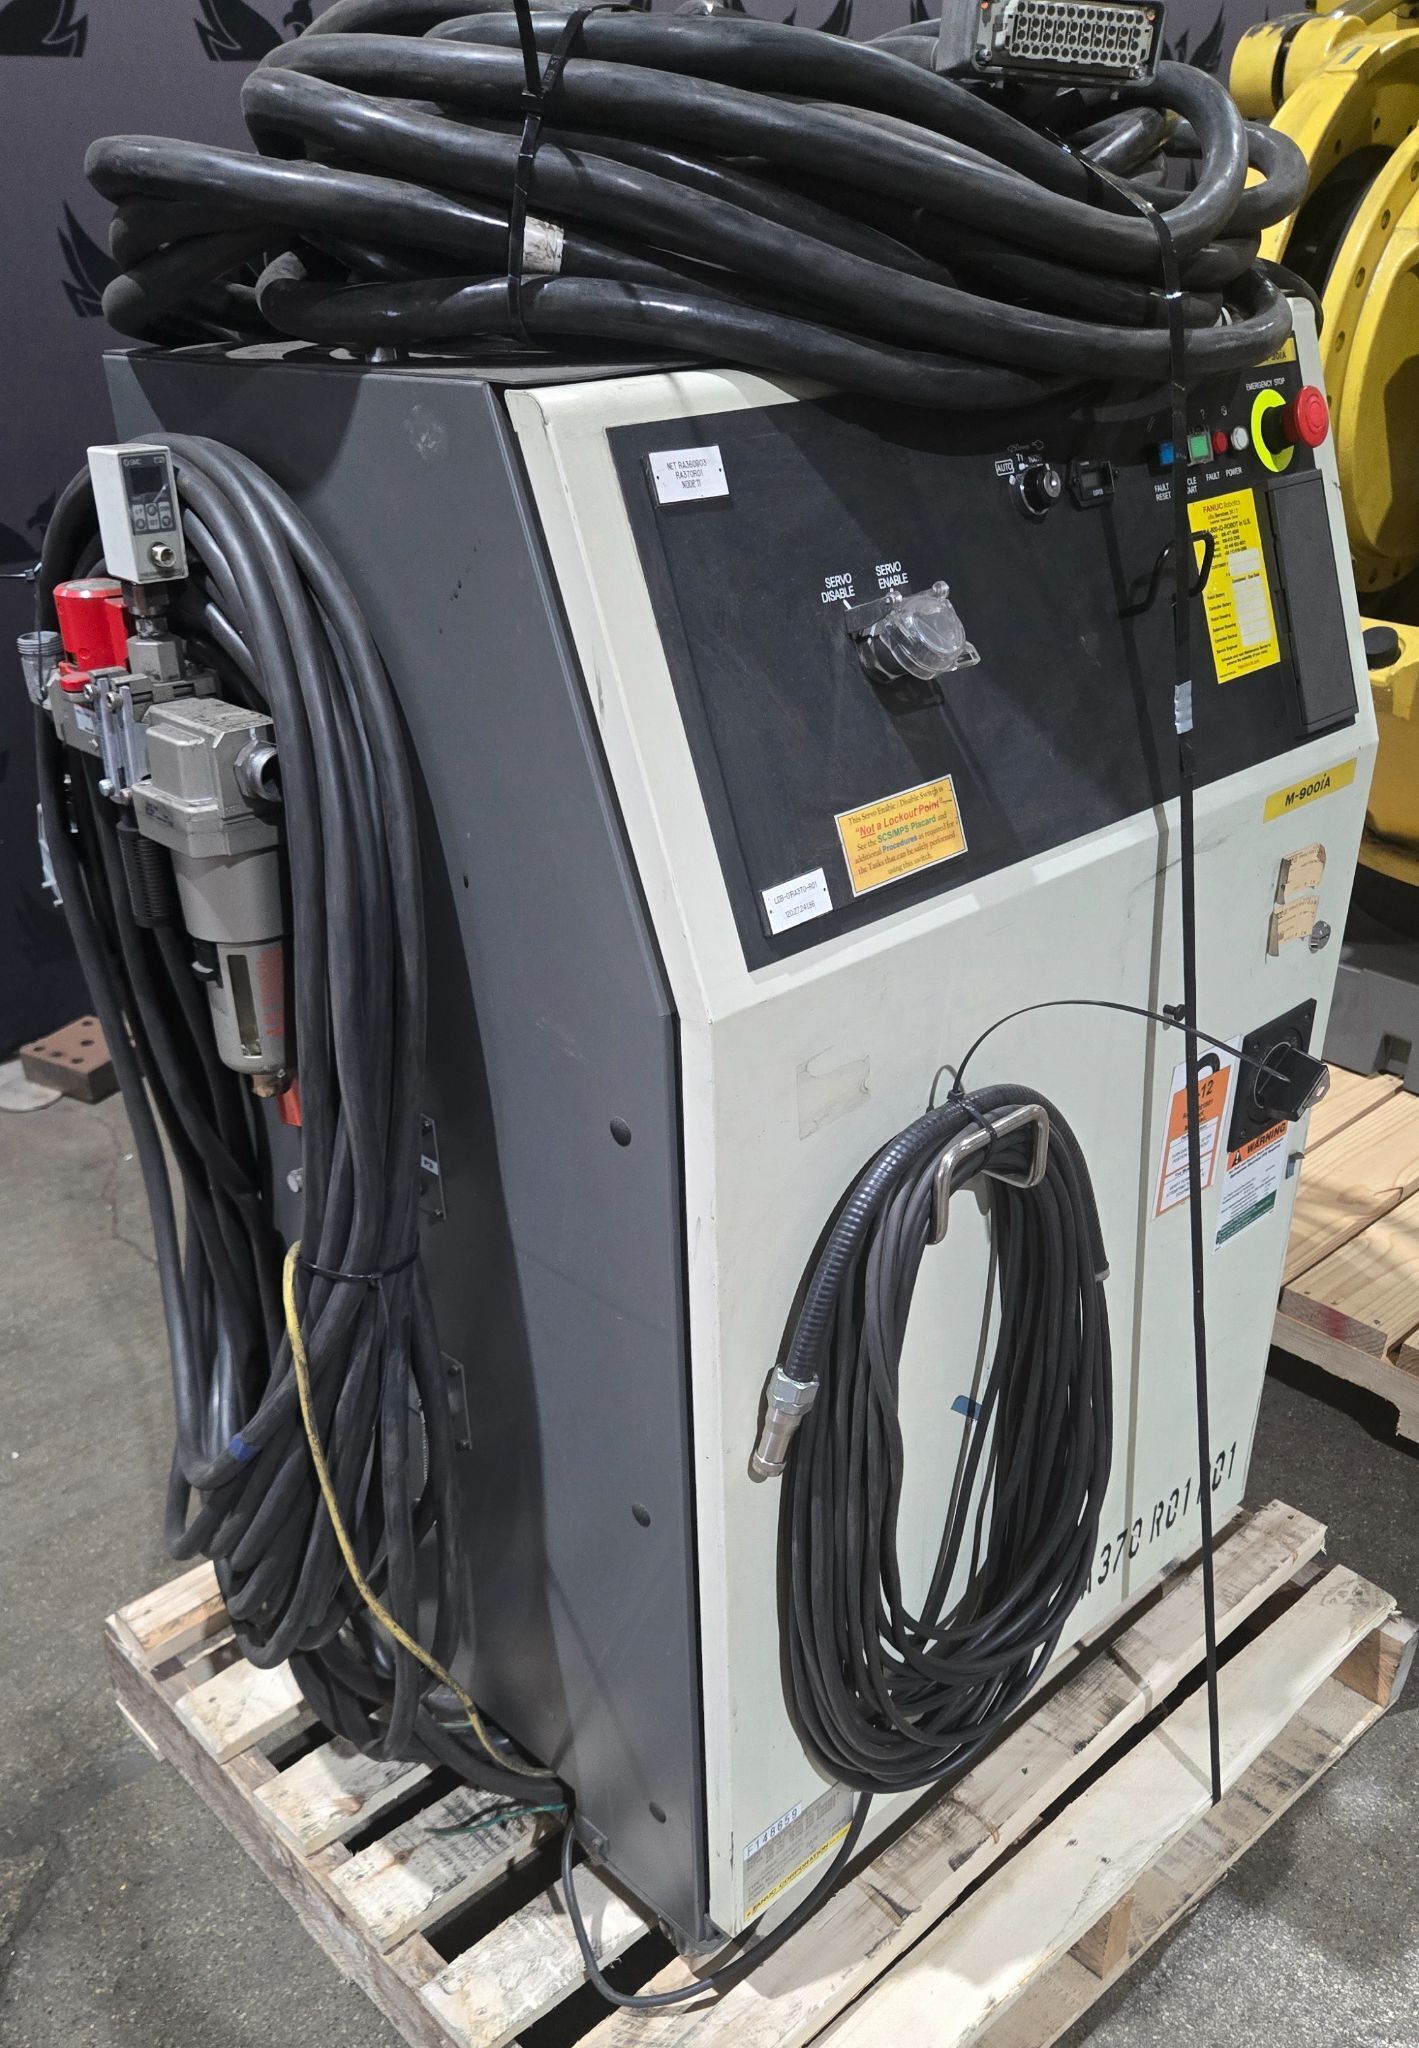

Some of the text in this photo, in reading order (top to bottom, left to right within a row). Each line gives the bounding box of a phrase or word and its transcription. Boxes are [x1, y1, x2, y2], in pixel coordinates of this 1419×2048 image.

[1245, 377, 1285, 391] EMERGENCY STOP
[666, 461, 677, 470] NET
[997, 462, 1013, 473] AUTO
[1225, 466, 1243, 478] POWER
[1206, 471, 1220, 481] FAULT
[1154, 482, 1170, 493] FAULT
[1155, 491, 1172, 502] RESET
[1202, 502, 1223, 513] FANUC
[875, 561, 902, 577] SERVO
[825, 573, 852, 589] SERVO
[878, 572, 909, 590] ENABLE
[821, 585, 856, 604] DISABLE
[848, 816, 861, 826] This
[861, 811, 877, 821] Servo
[877, 804, 896, 815] Enable
[899, 796, 919, 807] Disable
[876, 822, 882, 831] a
[883, 807, 918, 829] Lockout
[857, 811, 947, 852] See the SCS/MPS Placard and
[882, 835, 918, 854] Procedures
[924, 824, 946, 838] required
[946, 820, 954, 829] for
[858, 831, 956, 875] the Tasks that can be safely performed
[888, 864, 903, 875] using
[903, 860, 914, 870] this
[1247, 1122, 1287, 1154] WARNING
[1149, 1476, 1192, 1545] R01
[746, 1808, 798, 1858] F148659
[752, 1841, 830, 1912] FANUC CORPORATION
